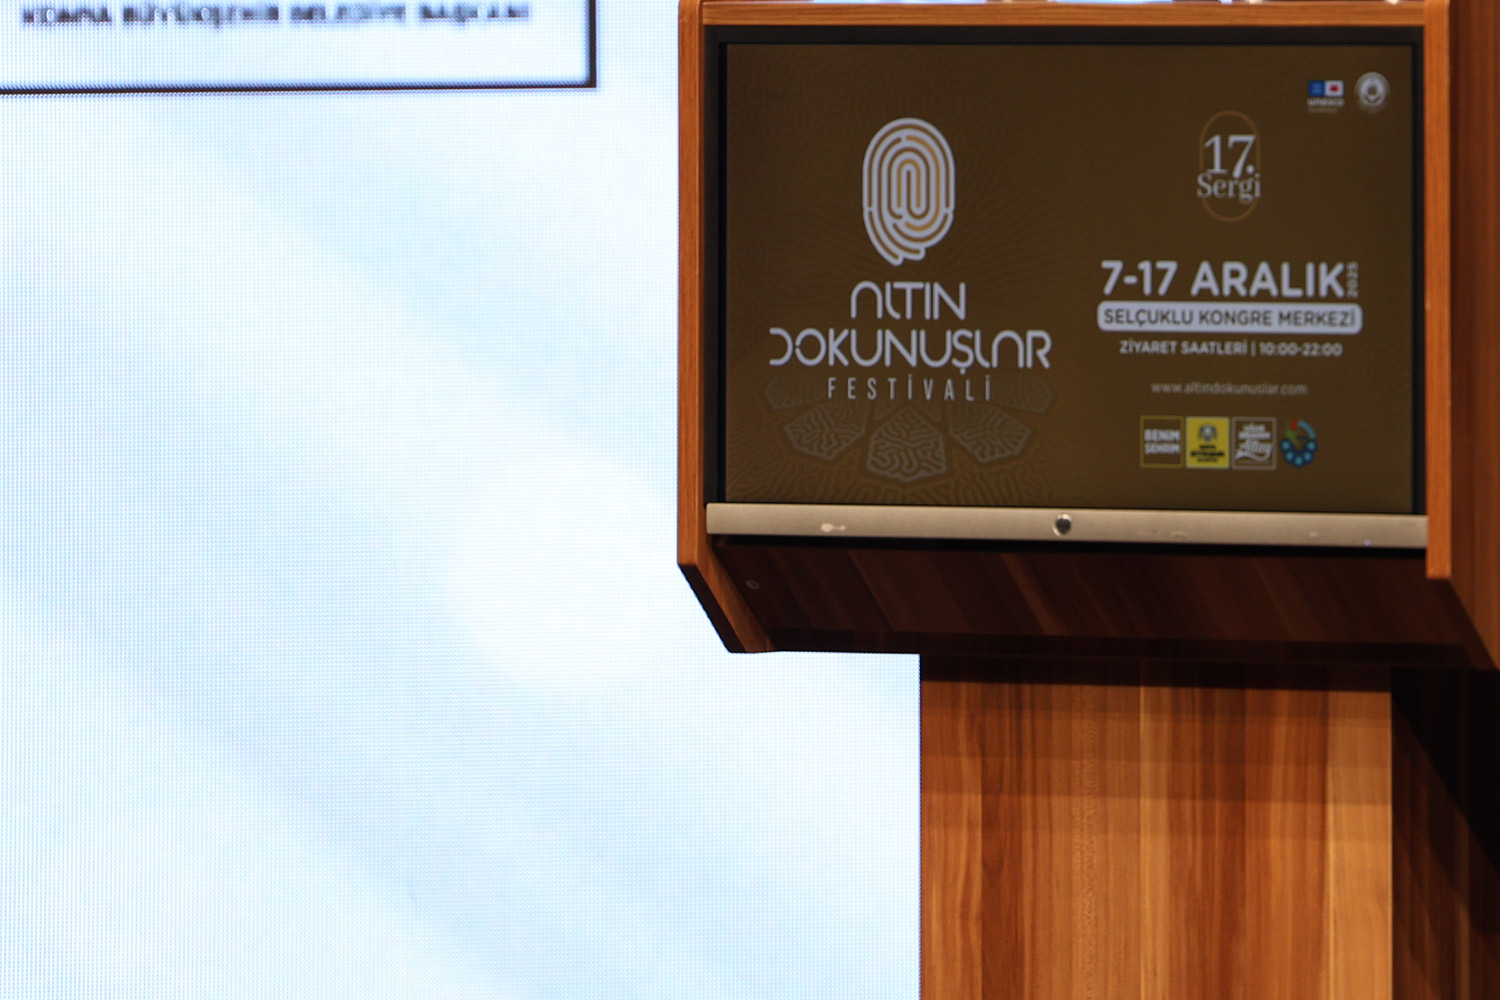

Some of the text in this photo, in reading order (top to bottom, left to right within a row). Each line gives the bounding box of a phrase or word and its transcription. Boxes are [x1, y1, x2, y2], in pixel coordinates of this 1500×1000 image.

[1203, 134, 1257, 178] 17.
[1197, 172, 1262, 205] Sergi
[1101, 260, 1345, 298] 7-17 ARALIK
[850, 281, 966, 320] ALTIN
[1104, 308, 1356, 327] SELÇUKLU KONGRE MERKEZİ
[769, 328, 1052, 374] DOKUNUŞLAR
[1119, 338, 1178, 355] ZİYARET
[1259, 341, 1343, 357] 10:00-22:00
[828, 375, 992, 401] FESTİVALİ
